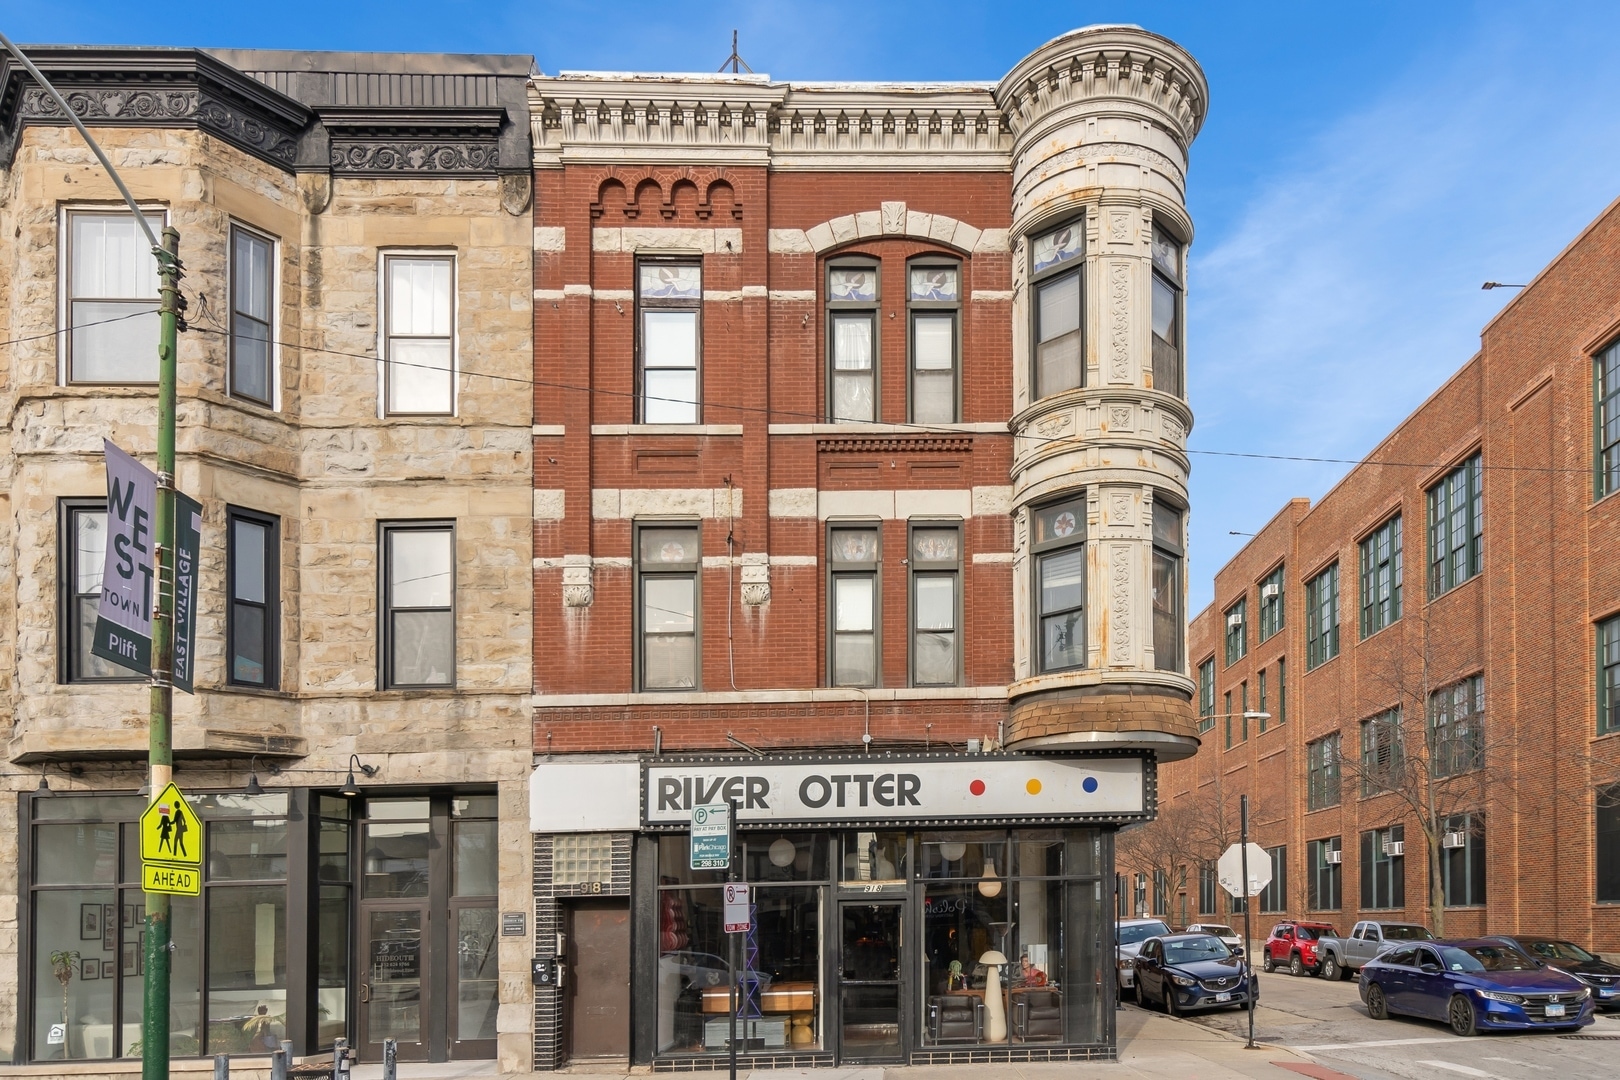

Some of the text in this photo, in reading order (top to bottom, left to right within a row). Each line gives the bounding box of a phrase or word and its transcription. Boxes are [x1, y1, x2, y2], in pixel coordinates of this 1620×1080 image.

[104, 588, 139, 618] TOWN
[175, 547, 192, 680] EAST VILLAGE
[108, 633, 138, 661] Plift
[658, 773, 921, 811] RIVER OTTER
[153, 871, 191, 888] AHEAD
[580, 882, 601, 894] 918
[864, 884, 882, 893] 918
